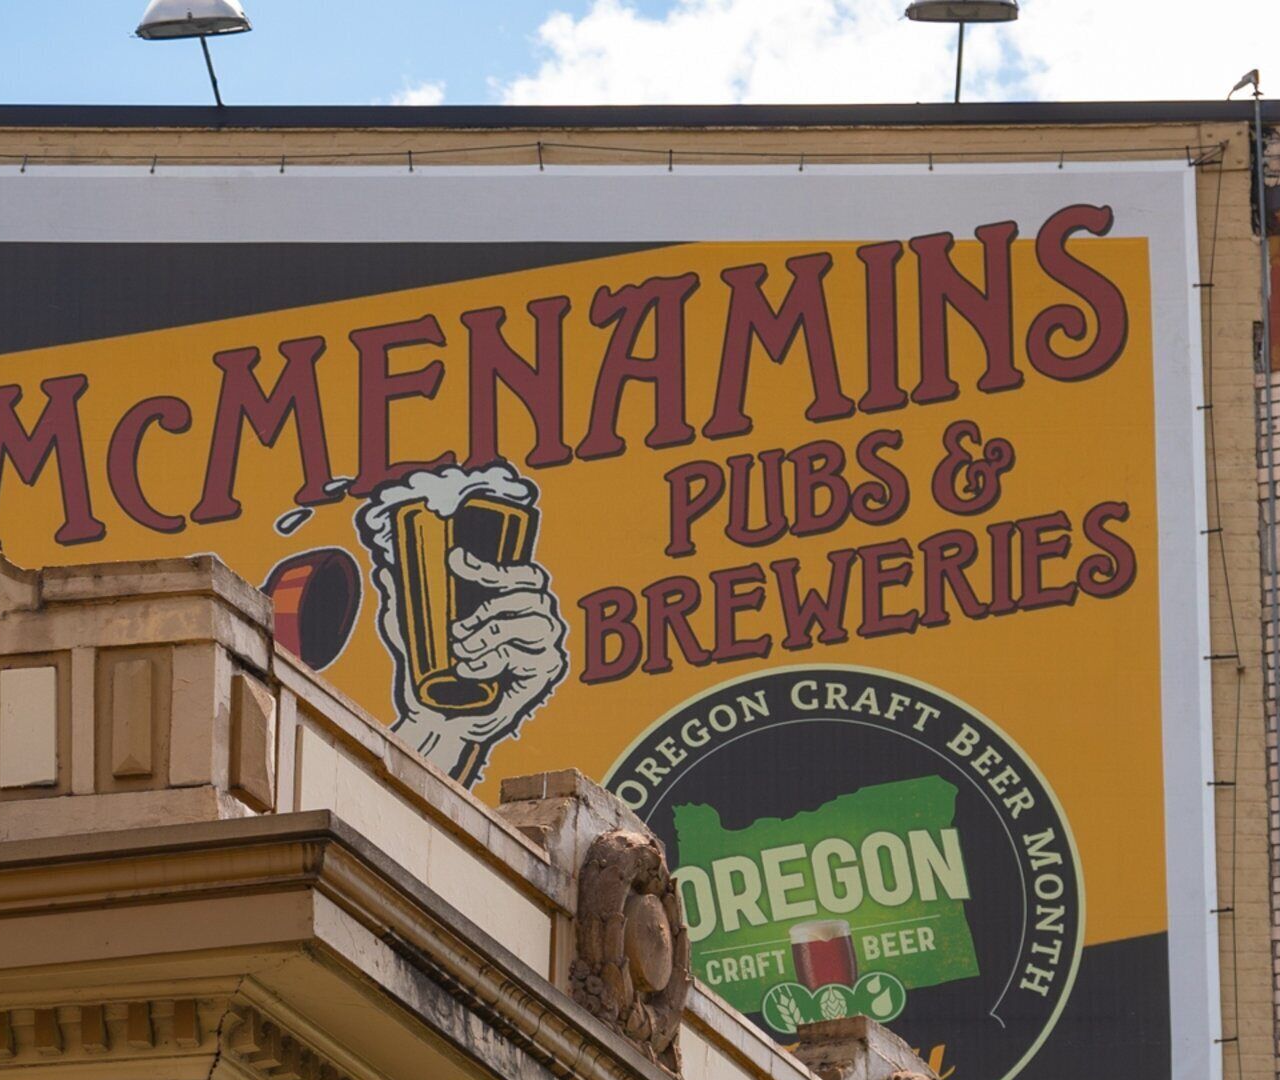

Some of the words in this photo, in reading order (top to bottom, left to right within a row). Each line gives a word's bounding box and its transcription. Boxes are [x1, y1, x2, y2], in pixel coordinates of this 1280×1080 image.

[664, 428, 910, 558] PUBS
[931, 420, 1015, 516] &
[577, 501, 1137, 685] BREWERIES
[615, 690, 770, 811] OREGON
[791, 680, 940, 732] CRAFT
[946, 723, 1035, 819] BEER
[1019, 827, 1066, 997] MONTH
[670, 828, 971, 943] OREGON
[706, 949, 786, 985] CRAFT
[862, 926, 936, 961] BEER
